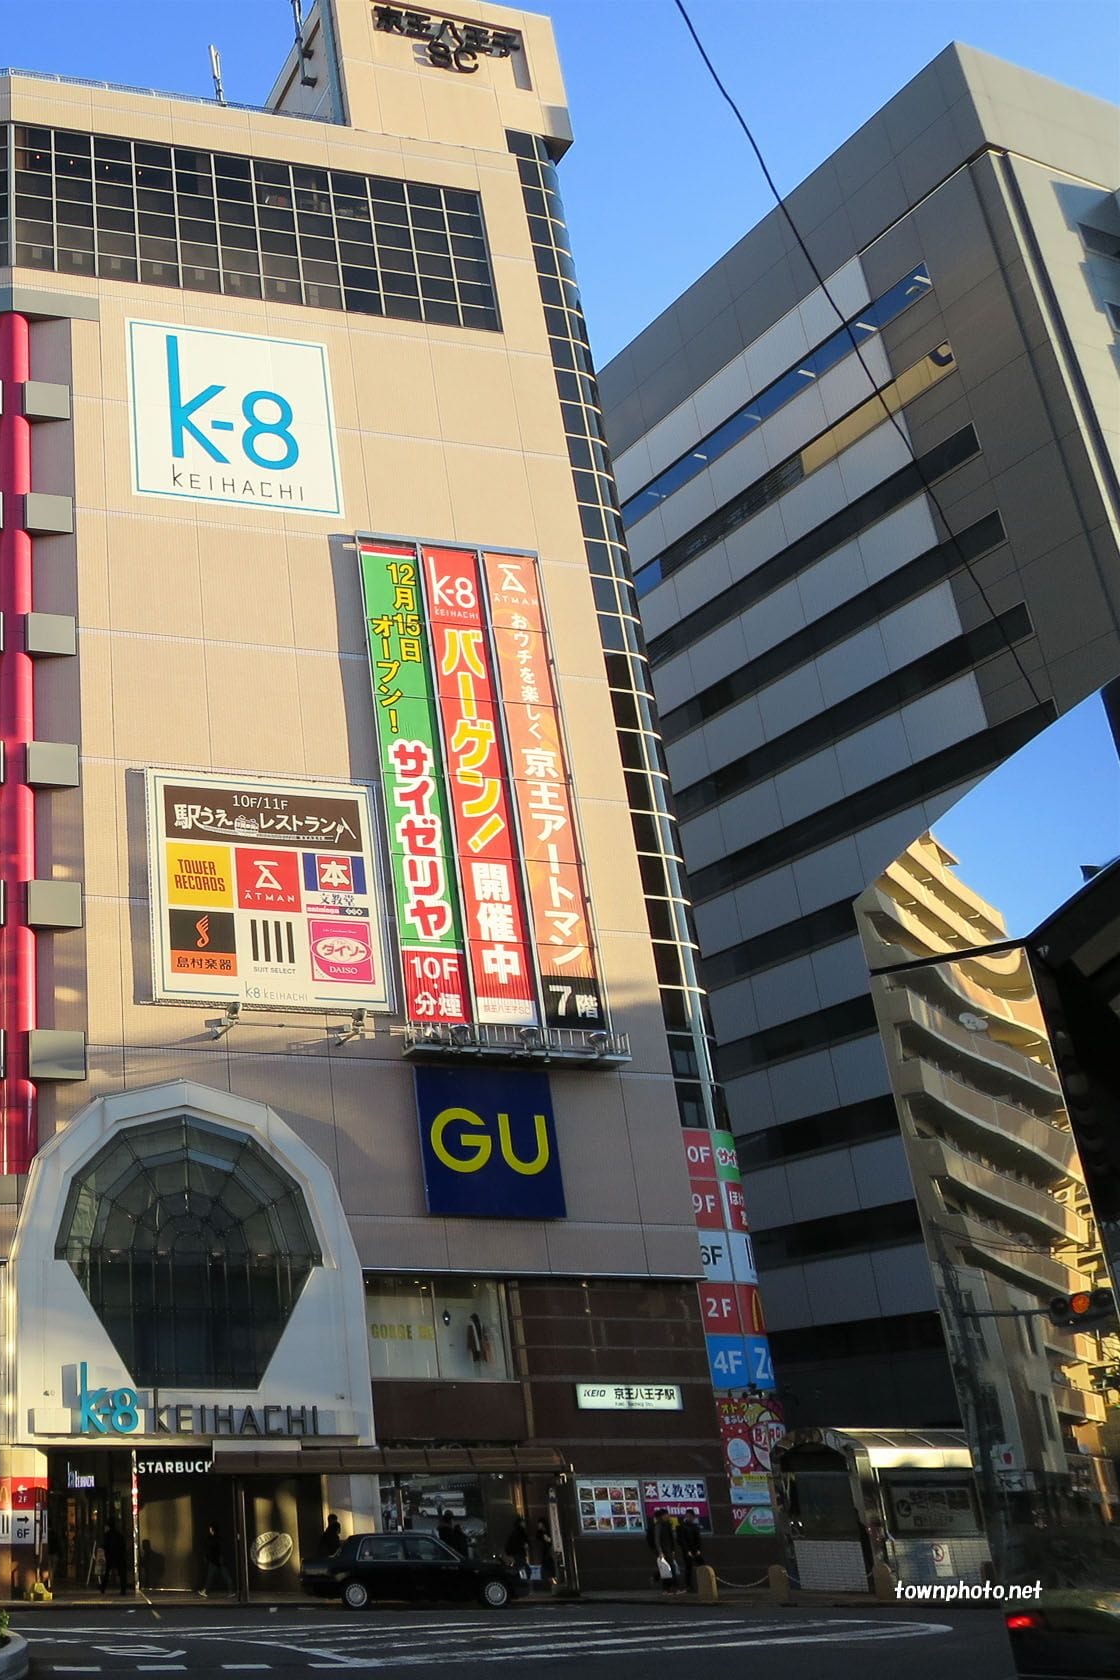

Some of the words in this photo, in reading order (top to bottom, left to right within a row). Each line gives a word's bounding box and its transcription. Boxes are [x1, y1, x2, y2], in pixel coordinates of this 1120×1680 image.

[428, 39, 480, 74] SC
[387, 562, 422, 663] 12月15日
[511, 612, 541, 740] おウチを楽しく
[387, 738, 453, 942] サイゼリヤ
[177, 859, 216, 875] TOWER
[521, 748, 586, 966] 京王アートマン
[174, 875, 226, 892] RECORDS
[320, 860, 350, 887] 本
[471, 862, 521, 985] 開催中
[322, 944, 365, 957] ダイソー
[176, 956, 232, 971] 島村楽器
[329, 966, 358, 975] DAISO
[410, 957, 458, 980] 10F
[414, 992, 463, 1018] 分煙
[548, 985, 598, 1018] 7階
[430, 1107, 550, 1175] GU
[691, 1193, 716, 1214] 9F
[706, 1298, 732, 1318] 2F
[714, 1351, 742, 1374] 4F
[584, 1390, 606, 1398] KEIO
[614, 1388, 676, 1400] 京王八王子駅
[153, 1388, 319, 1434] KEIHACHI
[17, 1529, 30, 1539] 6F
